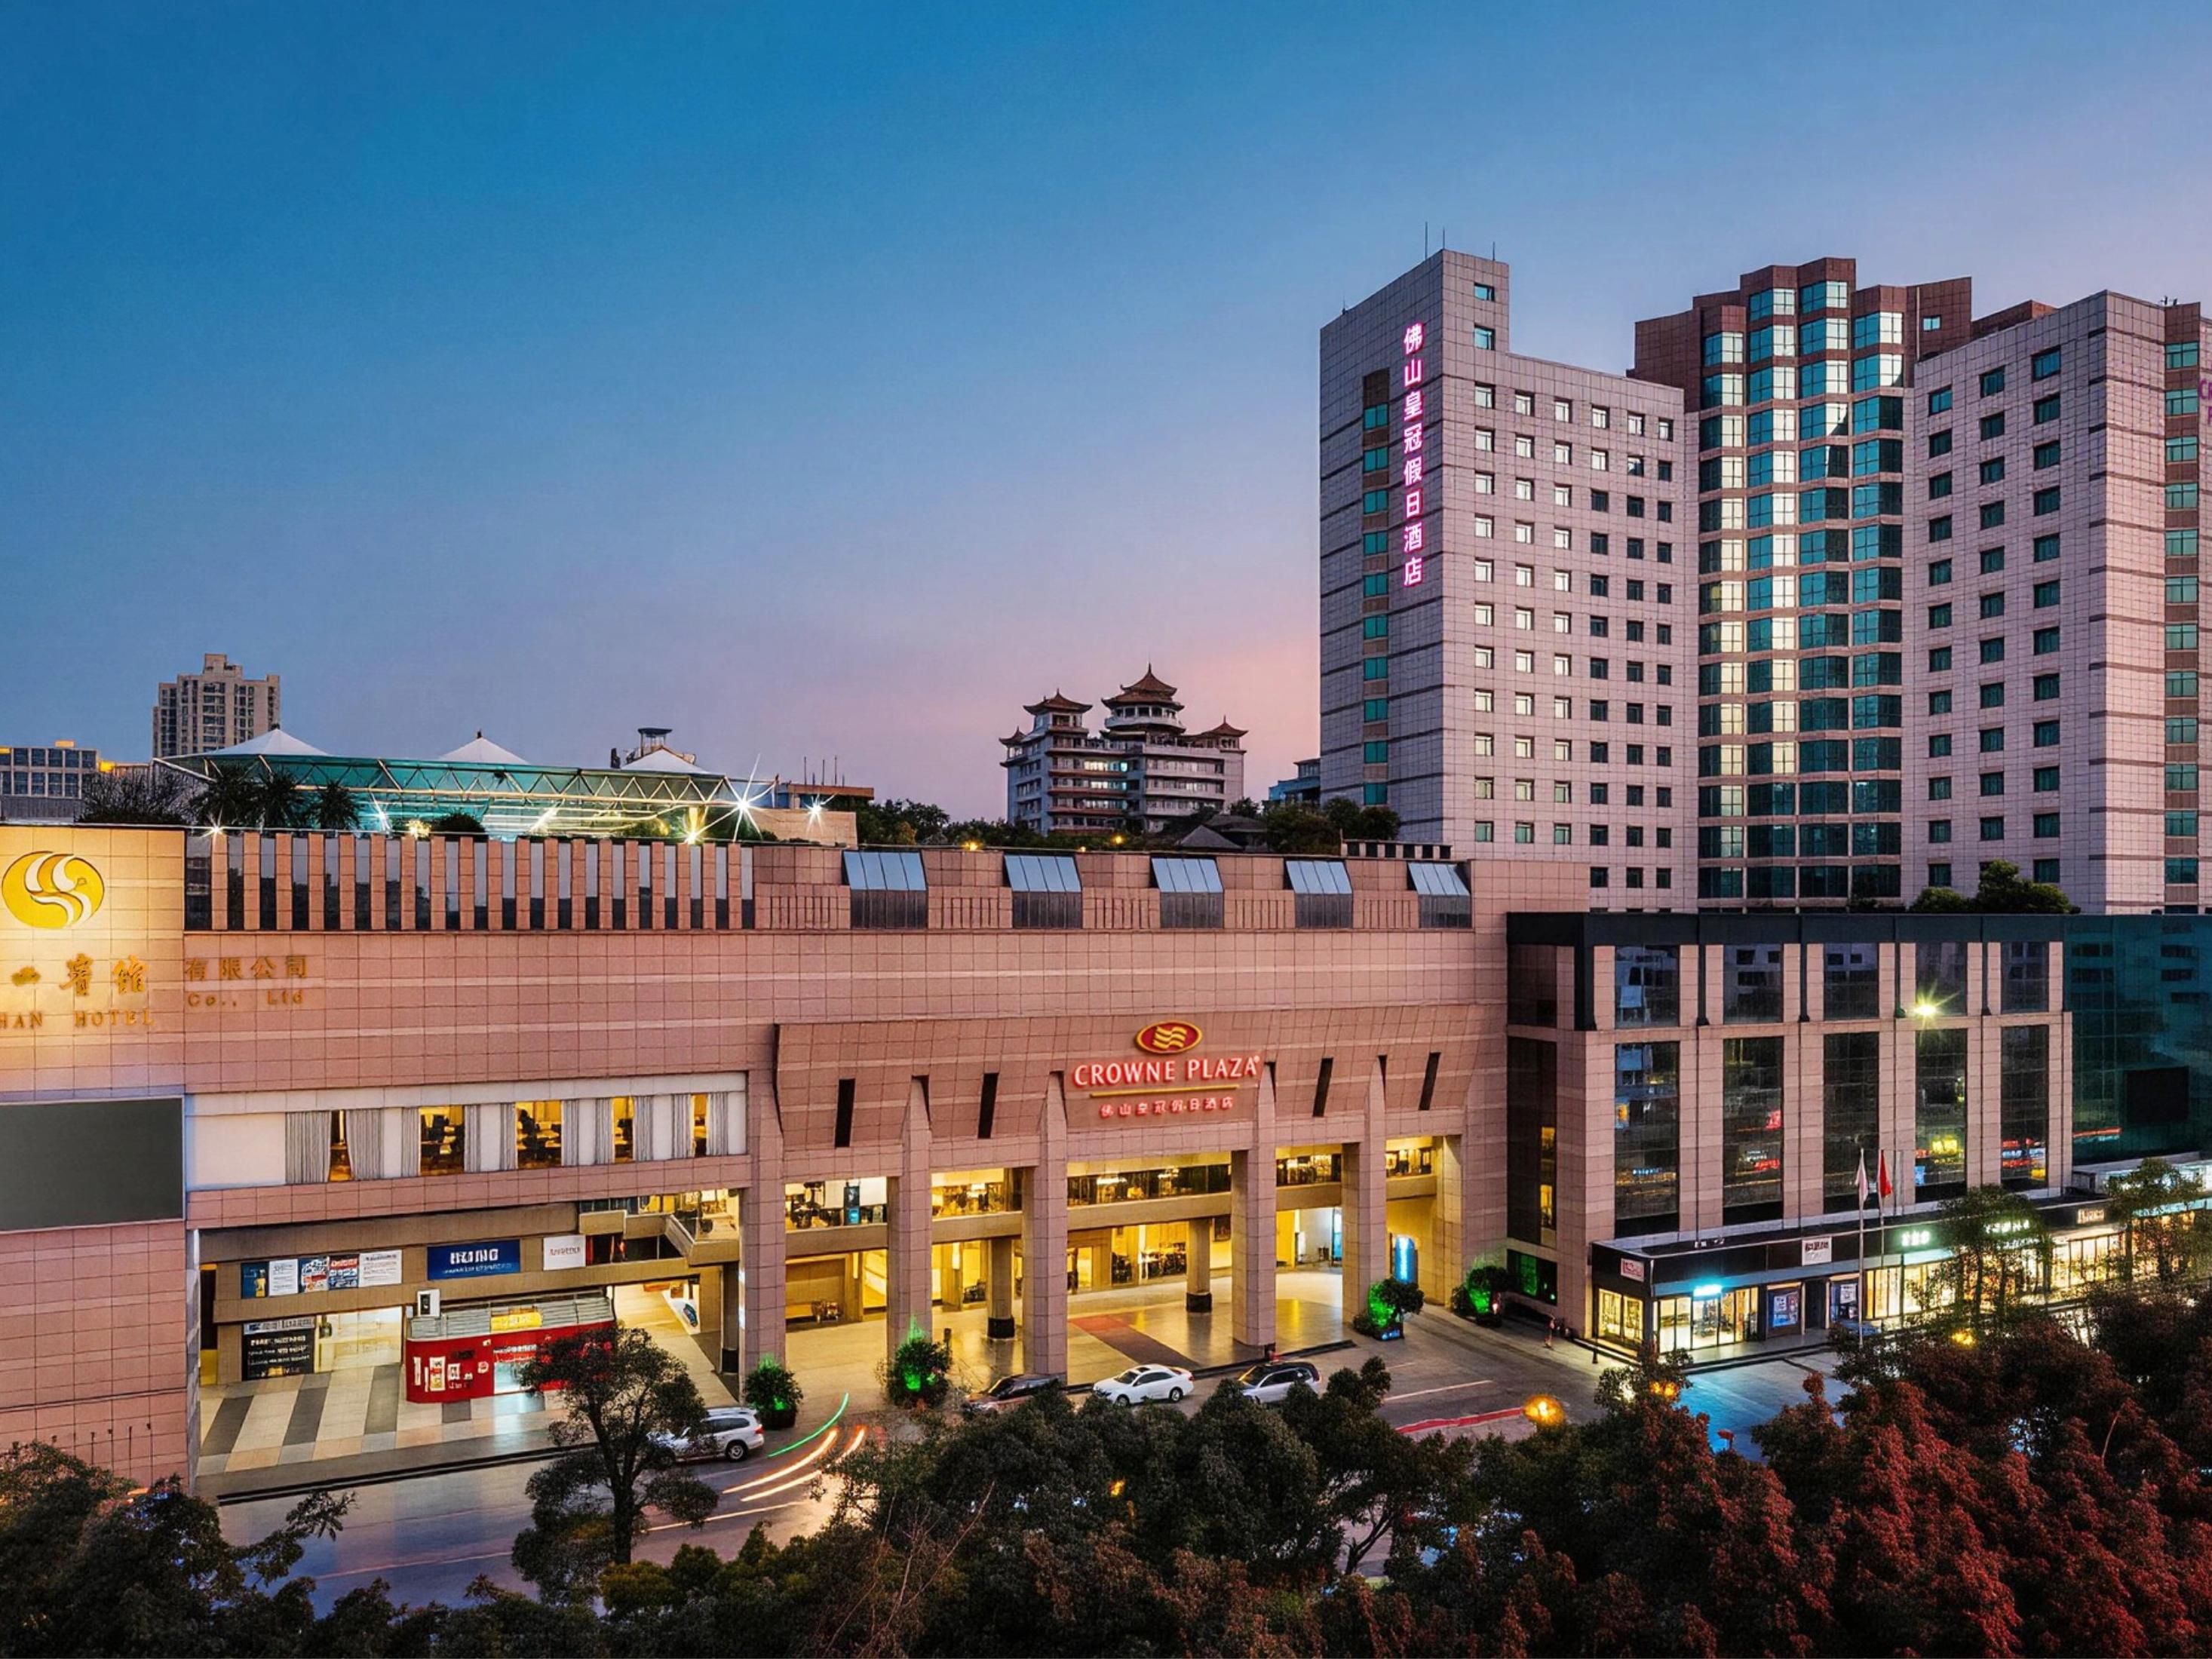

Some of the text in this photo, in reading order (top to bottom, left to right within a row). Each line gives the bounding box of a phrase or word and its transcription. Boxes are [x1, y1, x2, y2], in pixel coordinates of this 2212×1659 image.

[1403, 322, 1423, 586] 佛山皇冠假日酒店
[184, 955, 307, 981] 有限公司
[267, 989, 302, 1005] Ltd
[73, 1007, 155, 1027] HOTEL
[1073, 1059, 1176, 1087] CROWNE
[1099, 1096, 1234, 1118] 佛山皇冠假日酒店
